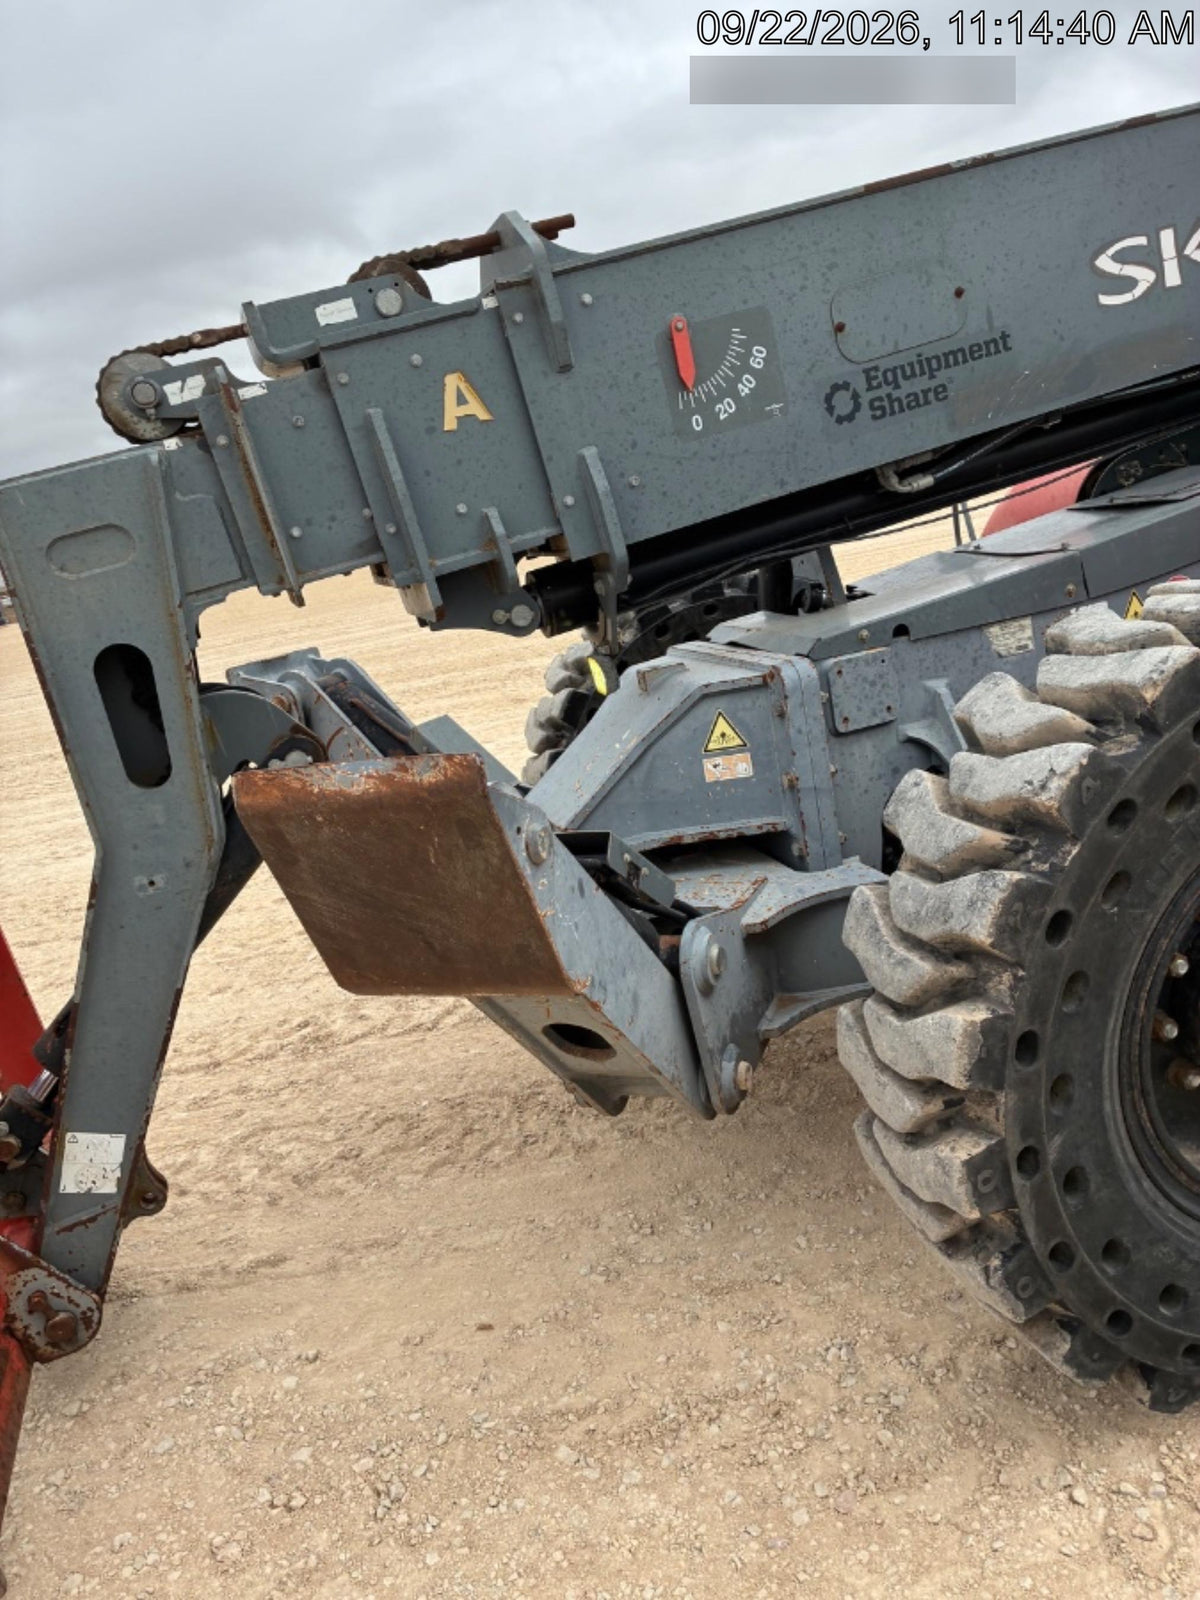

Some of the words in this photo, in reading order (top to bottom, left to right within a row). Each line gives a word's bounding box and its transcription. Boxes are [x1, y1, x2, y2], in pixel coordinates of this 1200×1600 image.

[749, 345, 767, 369] 60
[862, 329, 1013, 392] Equipment
[737, 374, 757, 397] 40
[443, 370, 494, 432] A
[715, 397, 736, 420] 20
[867, 382, 949, 421] Share
[691, 415, 703, 431] 0
